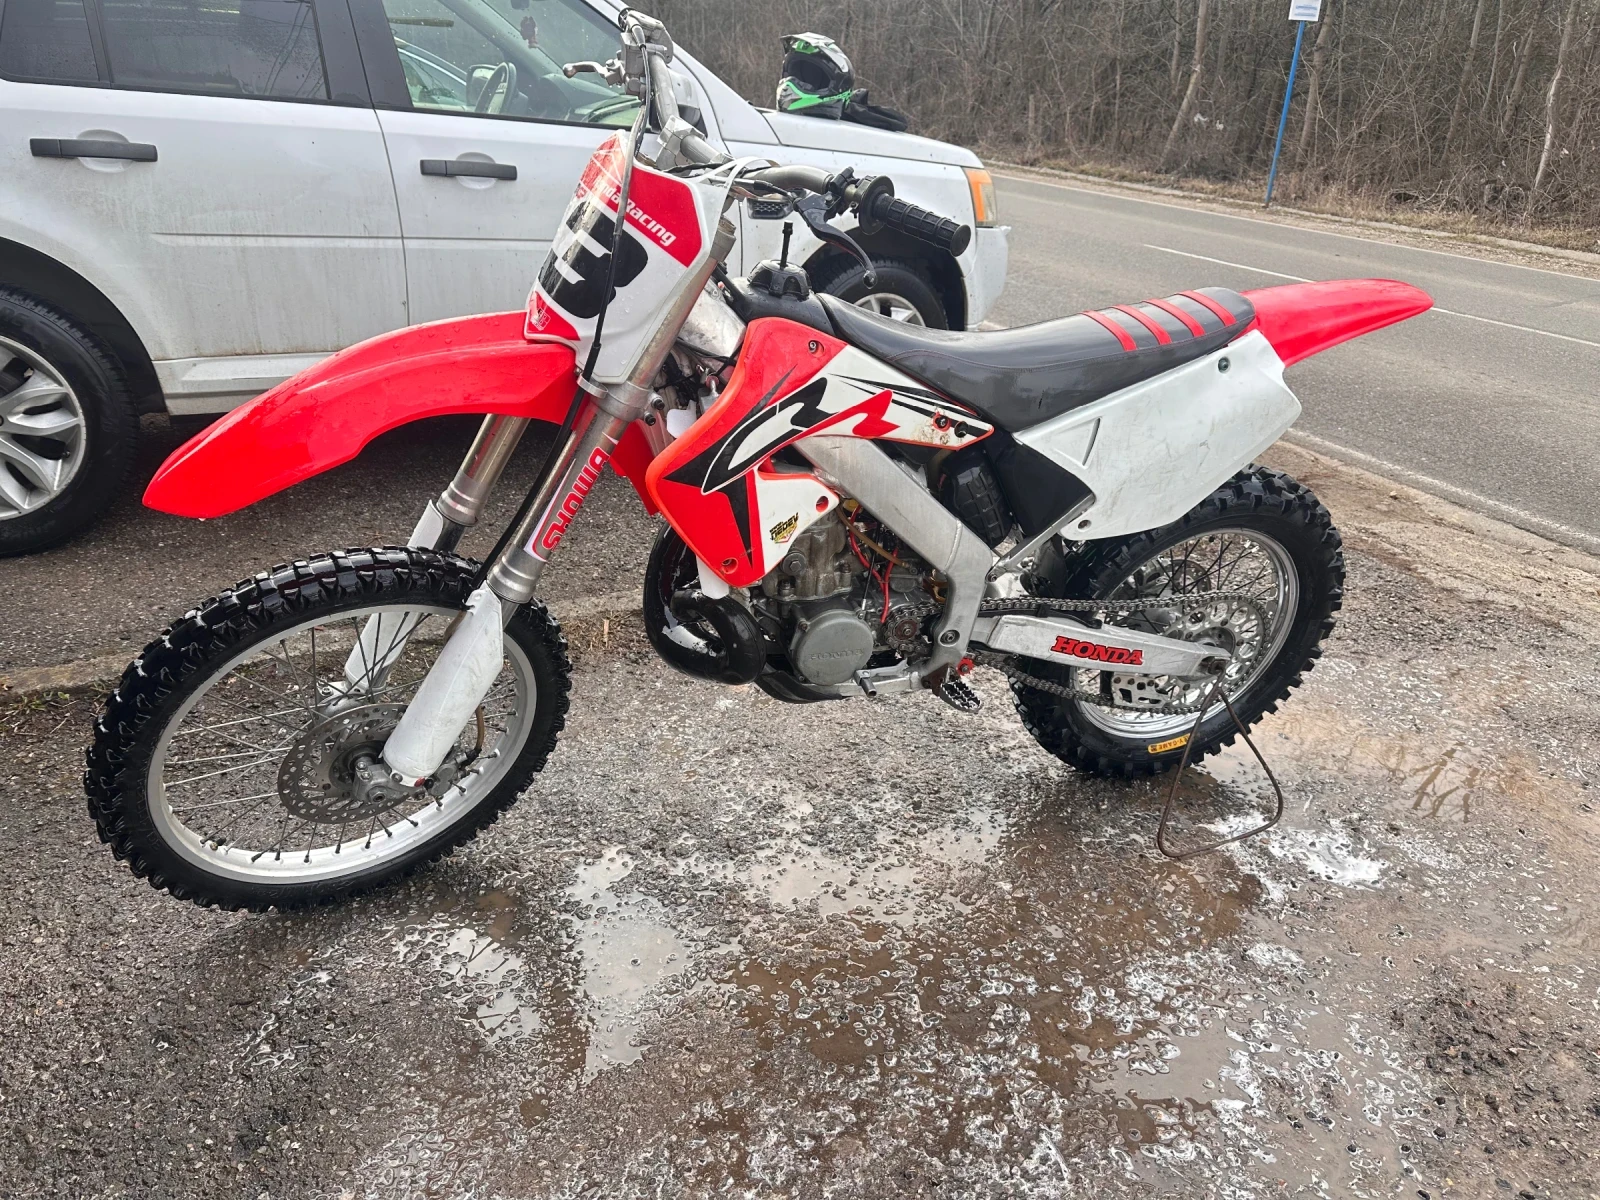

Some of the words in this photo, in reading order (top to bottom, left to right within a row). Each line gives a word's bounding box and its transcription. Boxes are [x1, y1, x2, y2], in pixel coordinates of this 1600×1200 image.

[592, 173, 621, 205] Hnda
[625, 198, 677, 247] Racing
[808, 648, 864, 660] HONDA
[1051, 636, 1143, 666] HONDA
